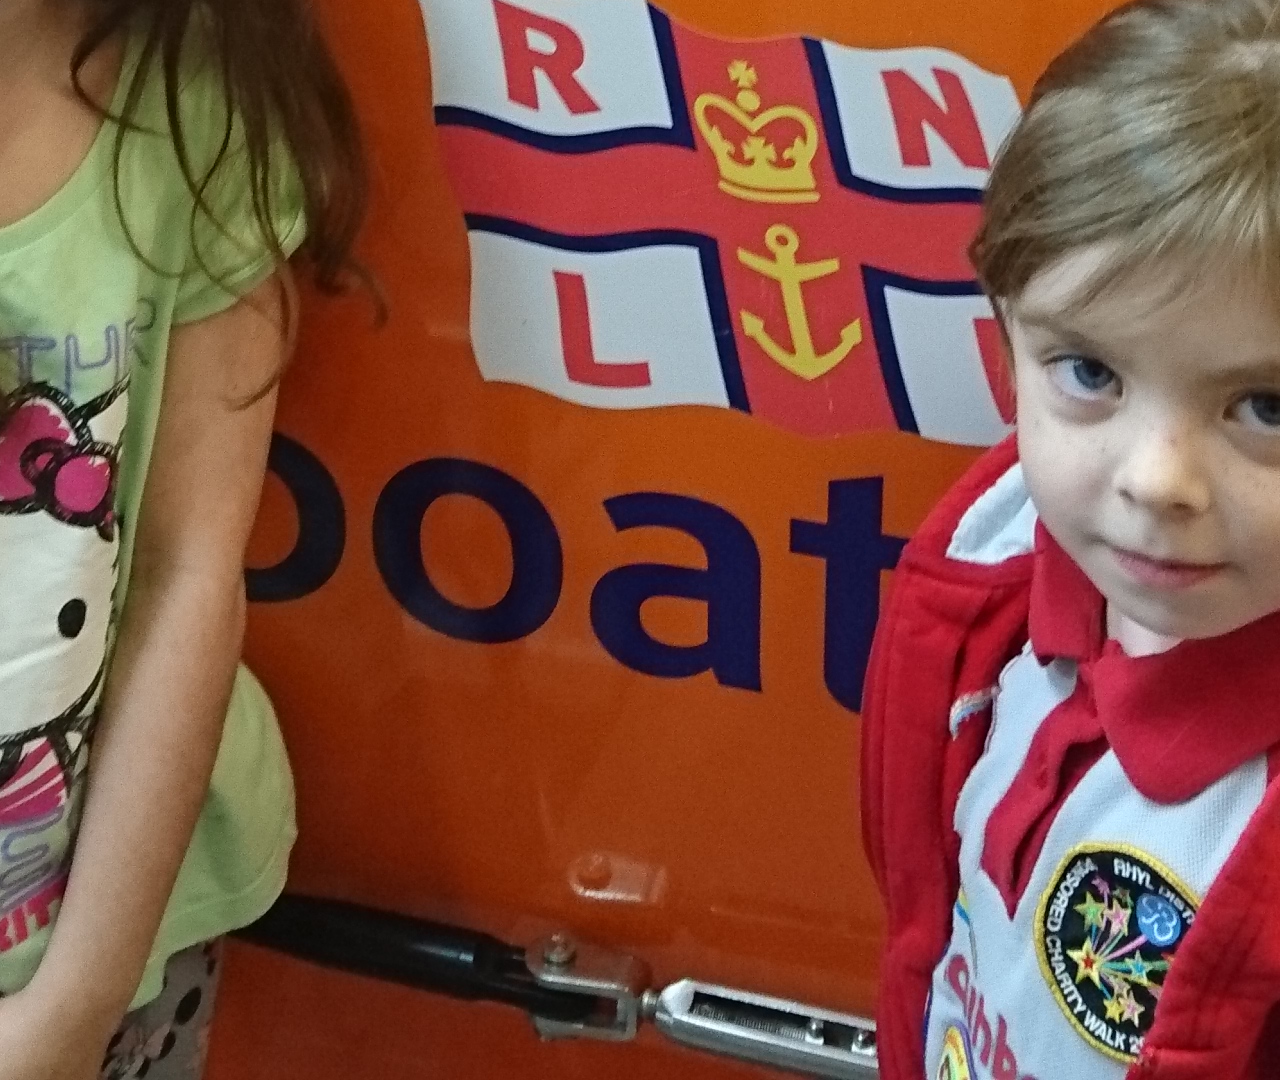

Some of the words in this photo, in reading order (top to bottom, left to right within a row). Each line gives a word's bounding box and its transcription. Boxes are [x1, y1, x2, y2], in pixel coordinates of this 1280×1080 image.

[883, 66, 990, 170] N
[553, 270, 650, 388] L
[1113, 858, 1155, 890] RHYL
[1158, 885, 1195, 924] DIST
[1045, 934, 1087, 1015] CHARITY
[1083, 1009, 1125, 1051] WALK
